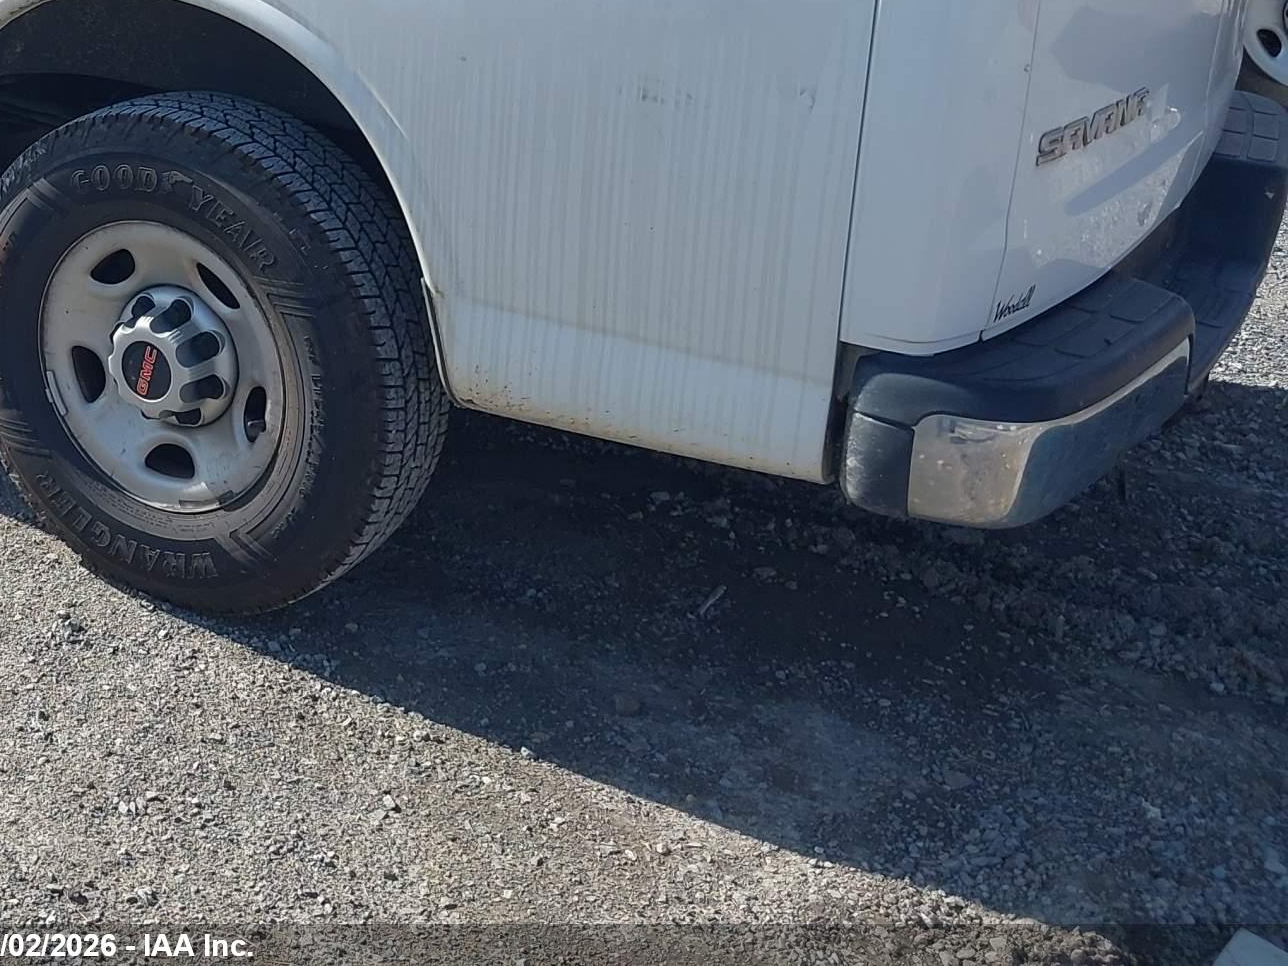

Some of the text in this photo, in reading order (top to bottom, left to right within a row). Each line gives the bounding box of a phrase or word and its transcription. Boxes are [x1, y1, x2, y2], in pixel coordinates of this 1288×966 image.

[1036, 86, 1150, 167] SAVANA
[136, 345, 158, 395] GMC
[35, 470, 219, 579] WRANGLER
